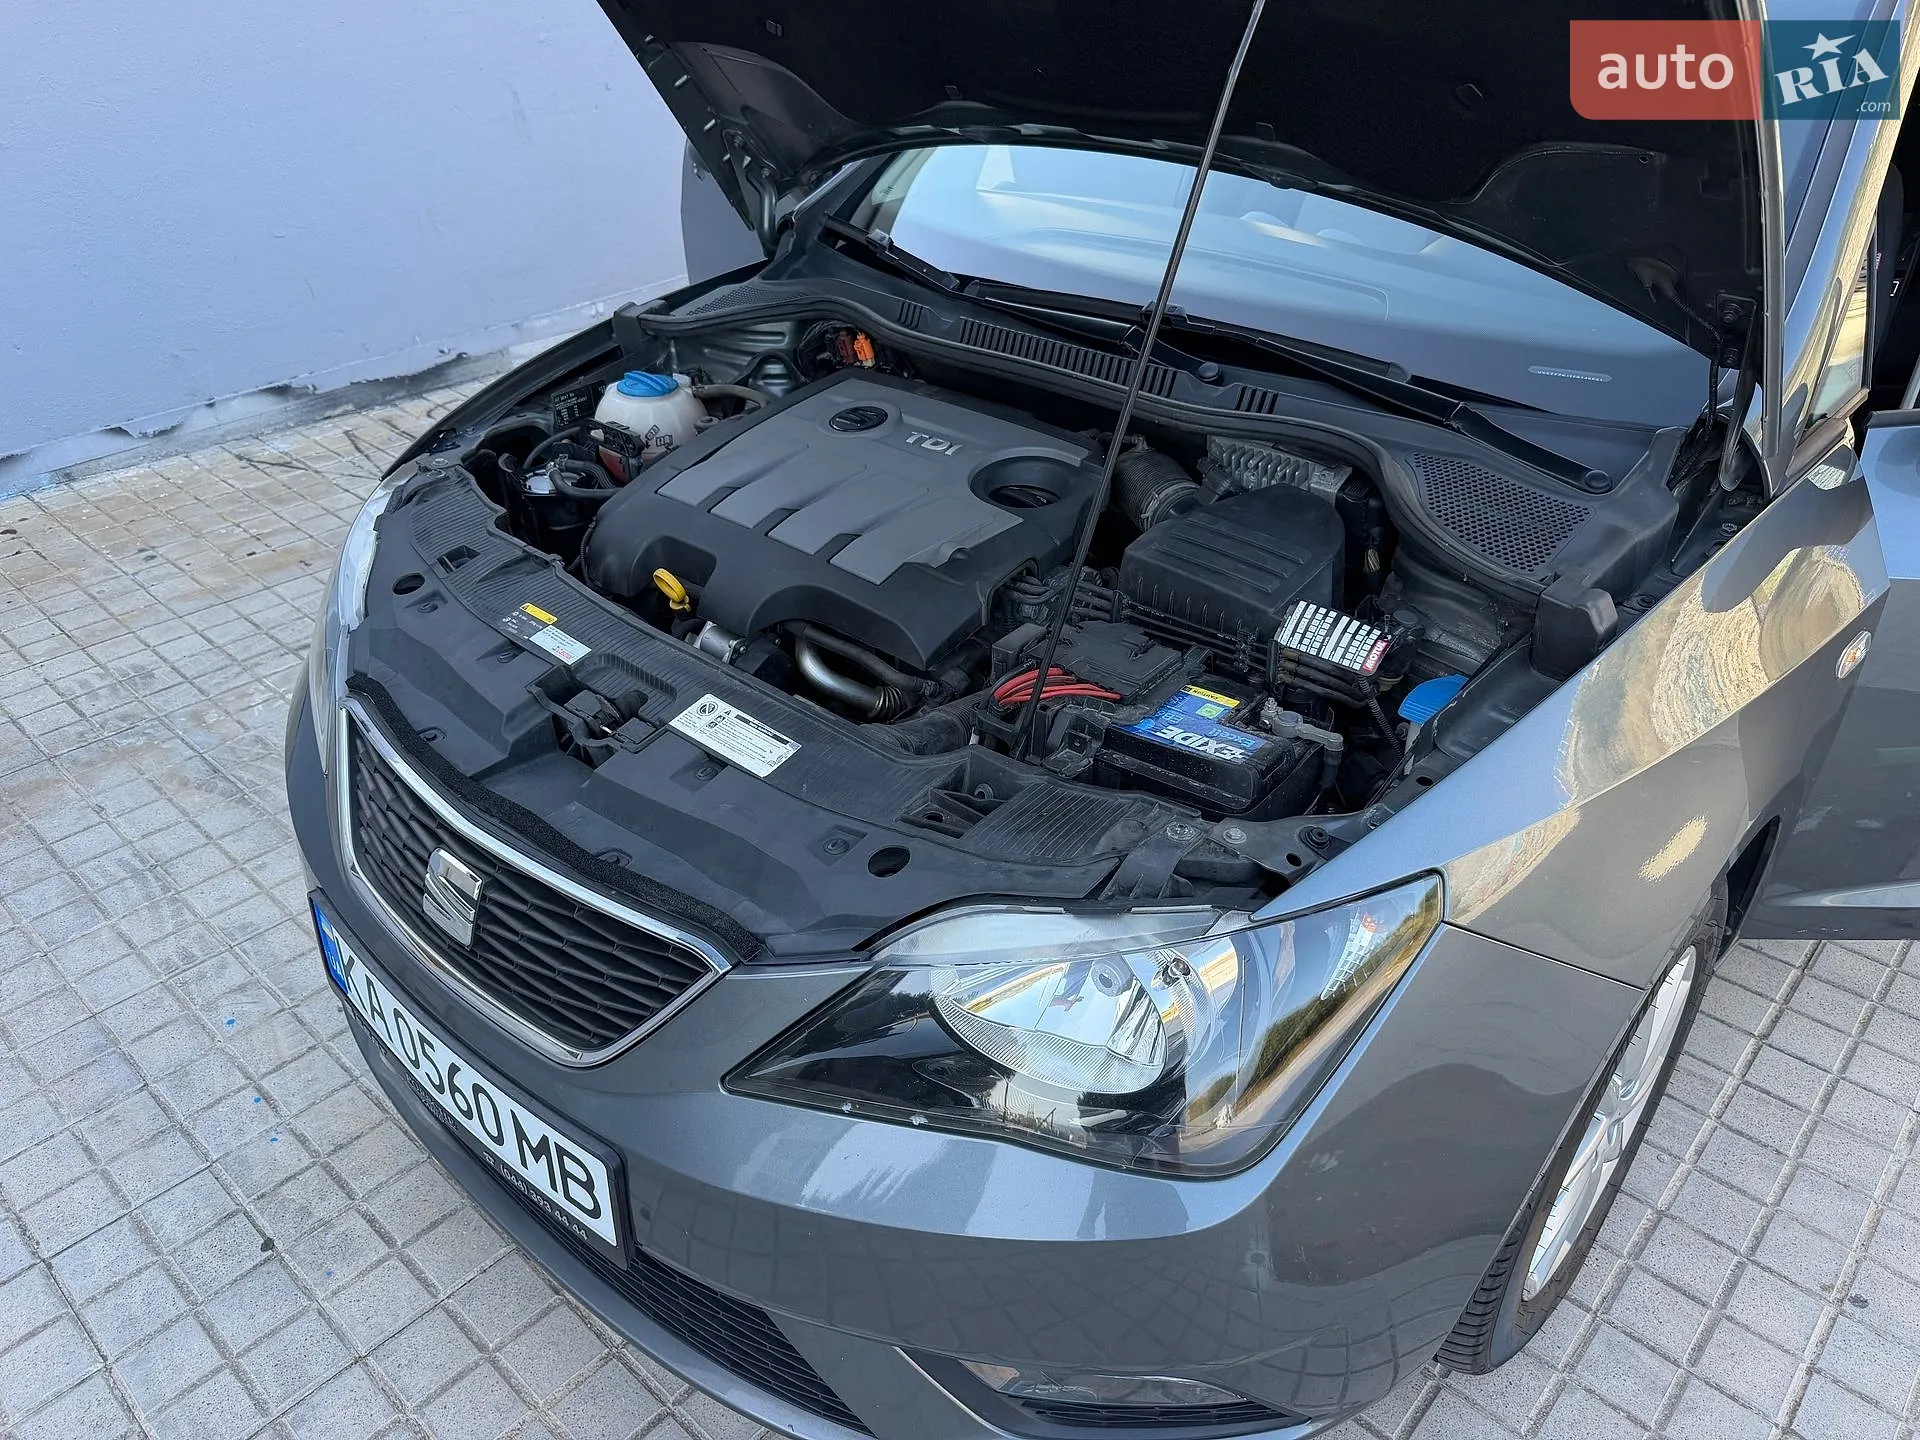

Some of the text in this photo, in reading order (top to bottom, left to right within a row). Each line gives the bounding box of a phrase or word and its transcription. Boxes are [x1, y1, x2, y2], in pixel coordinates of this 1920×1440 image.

[906, 431, 963, 457] TDI
[1364, 638, 1387, 672] MOTUL
[1156, 725, 1246, 760] EXIDE
[334, 935, 394, 1043] KA
[393, 1008, 505, 1146] 0560
[511, 1108, 602, 1220] MB
